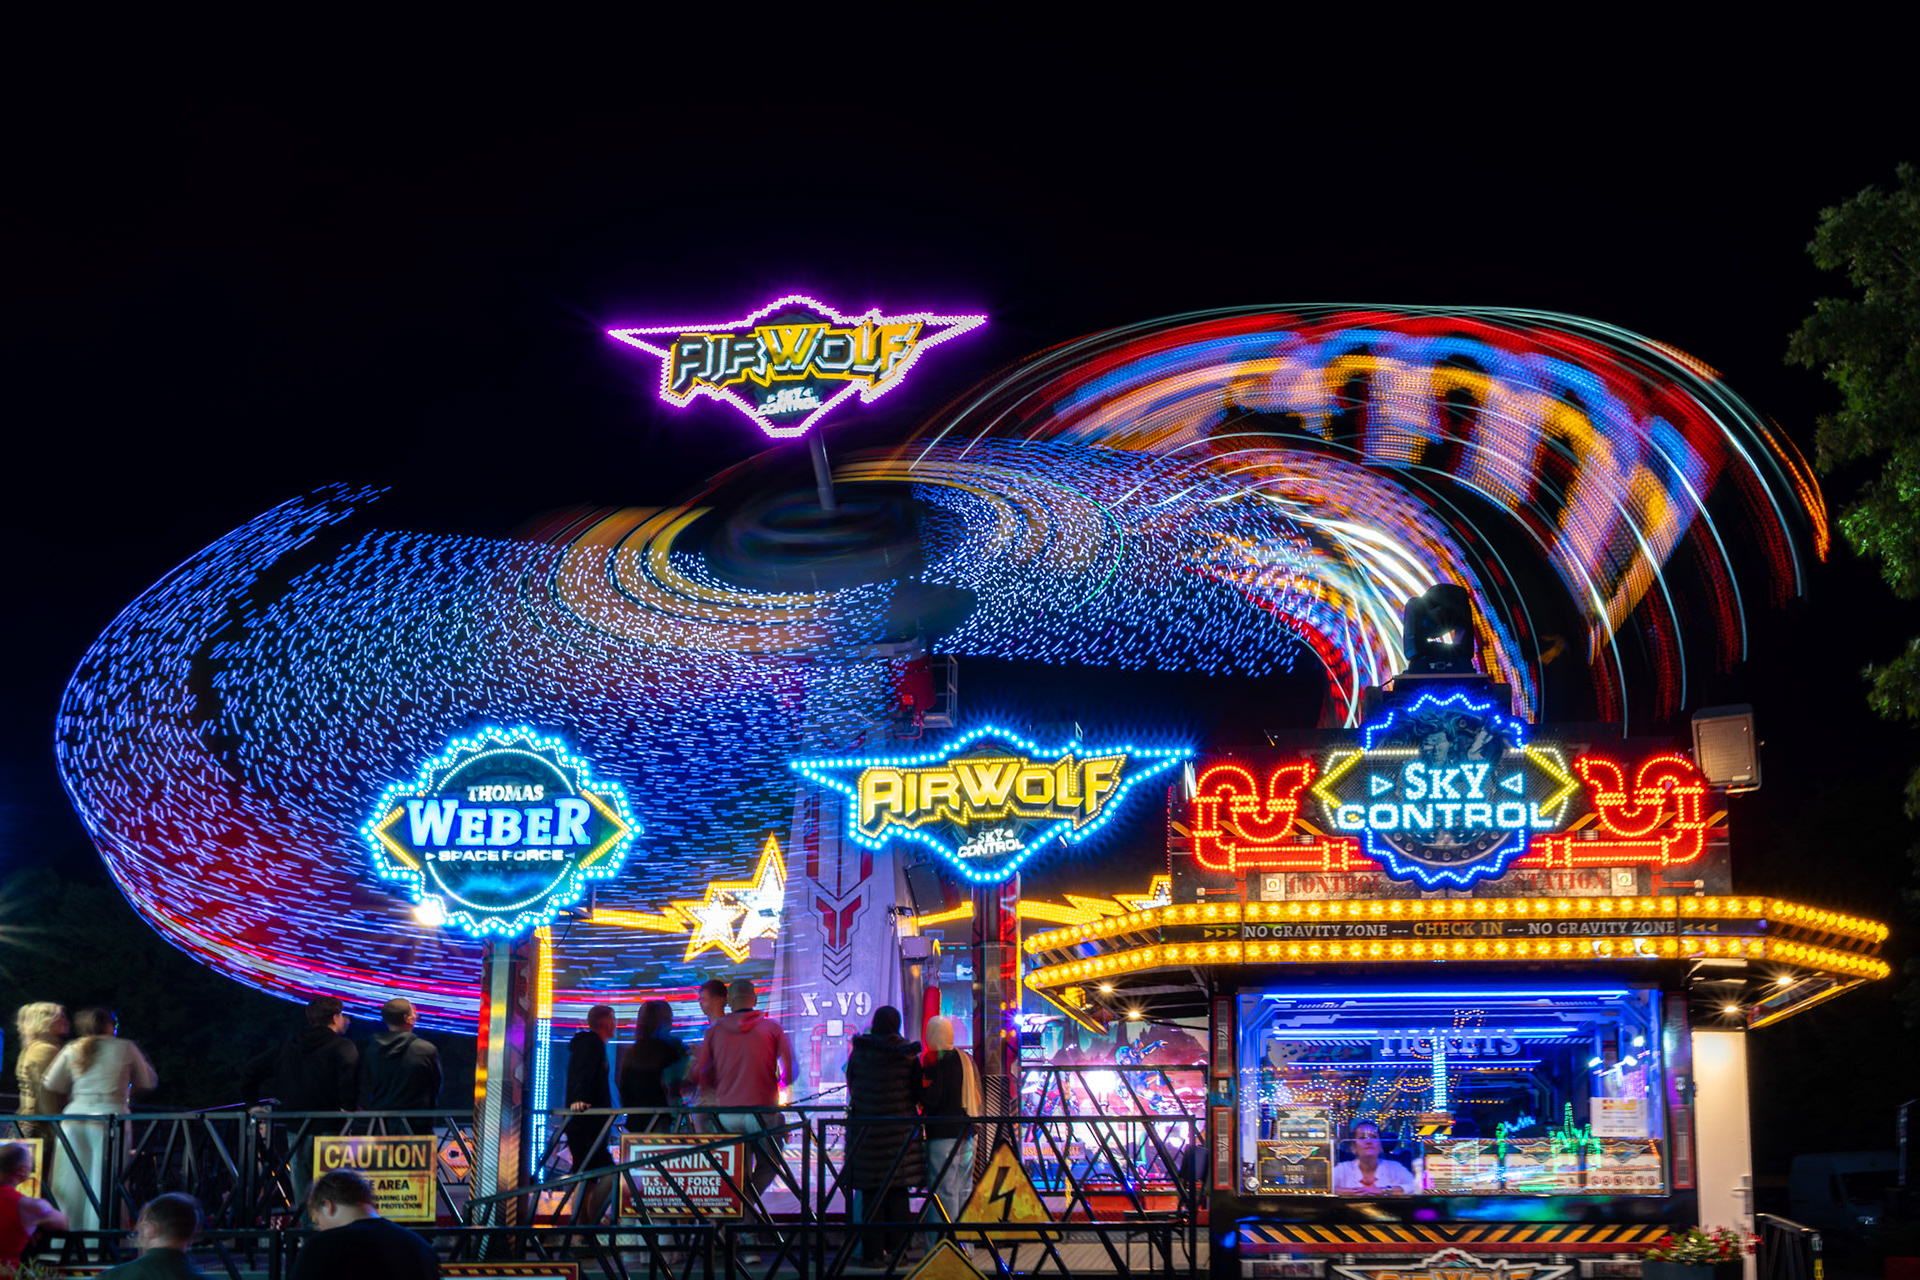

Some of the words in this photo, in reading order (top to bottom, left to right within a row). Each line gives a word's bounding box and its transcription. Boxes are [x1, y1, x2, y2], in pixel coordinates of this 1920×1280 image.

[671, 321, 922, 394] AIRWOLF
[467, 784, 544, 802] THOMAS
[862, 757, 1119, 826] AIRWOLF
[1405, 762, 1490, 801] SKY
[406, 798, 591, 847] WEBER
[1337, 802, 1554, 831] CONTROL
[978, 828, 1004, 843] SKY
[438, 850, 499, 862] SPACE
[502, 849, 564, 861] FORCE
[957, 838, 1025, 858] CONTROL
[1289, 874, 1380, 894] CONTROL
[1515, 871, 1606, 890] STATION
[1244, 926, 1268, 938] NO
[1272, 925, 1341, 937] GRAVITY
[1345, 924, 1388, 937] ZONE
[1413, 922, 1475, 936] CHECK
[1482, 922, 1503, 935] IN
[1528, 923, 1552, 934] NO
[1557, 922, 1628, 934] GRAVITY
[1633, 921, 1676, 933] ZONE
[801, 991, 871, 1016] X-V9
[1378, 1028, 1520, 1056] TICKETS
[324, 1144, 426, 1169] CAUTION
[378, 1179, 410, 1190] AREA
[642, 1177, 663, 1186] U.S.
[687, 1177, 721, 1187] FORCE
[643, 1186, 719, 1196] INSTAATION
